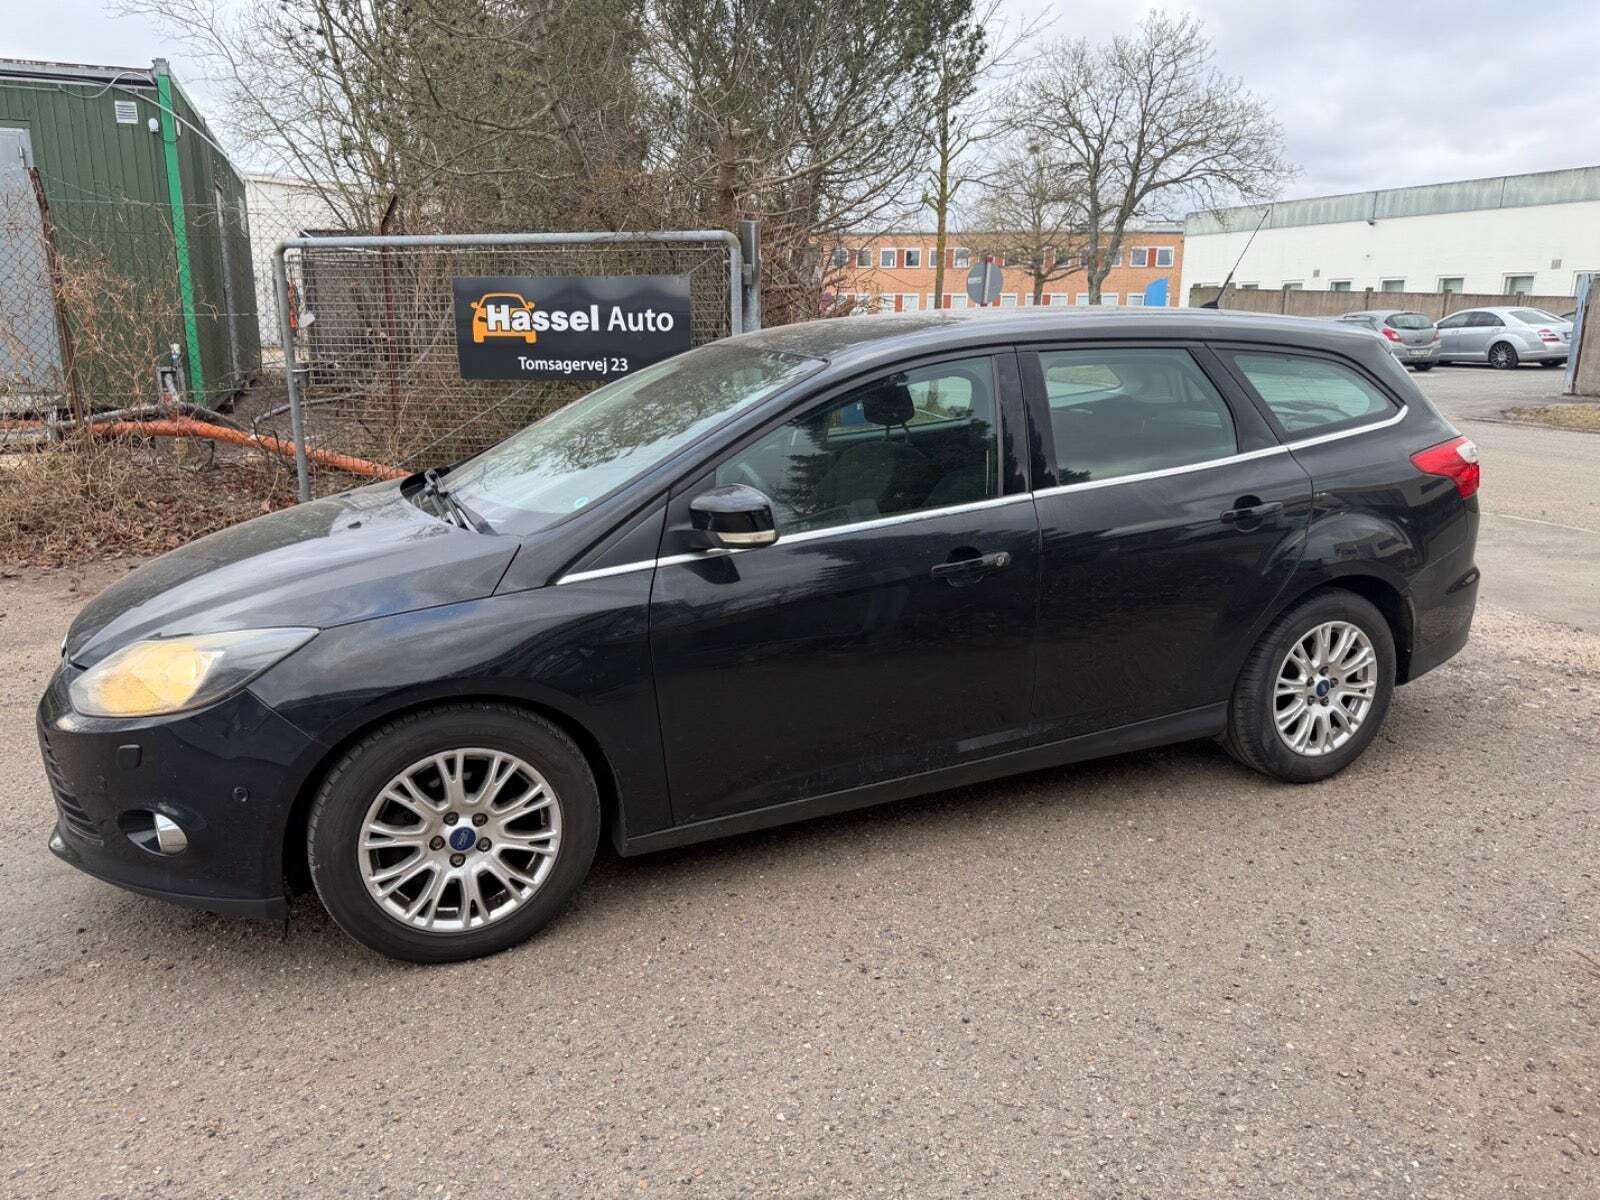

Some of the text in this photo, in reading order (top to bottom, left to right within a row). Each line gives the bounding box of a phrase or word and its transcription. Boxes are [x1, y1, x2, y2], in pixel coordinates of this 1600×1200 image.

[486, 304, 674, 332] Hassel Auto
[517, 356, 629, 374] Tomsagervej 23
